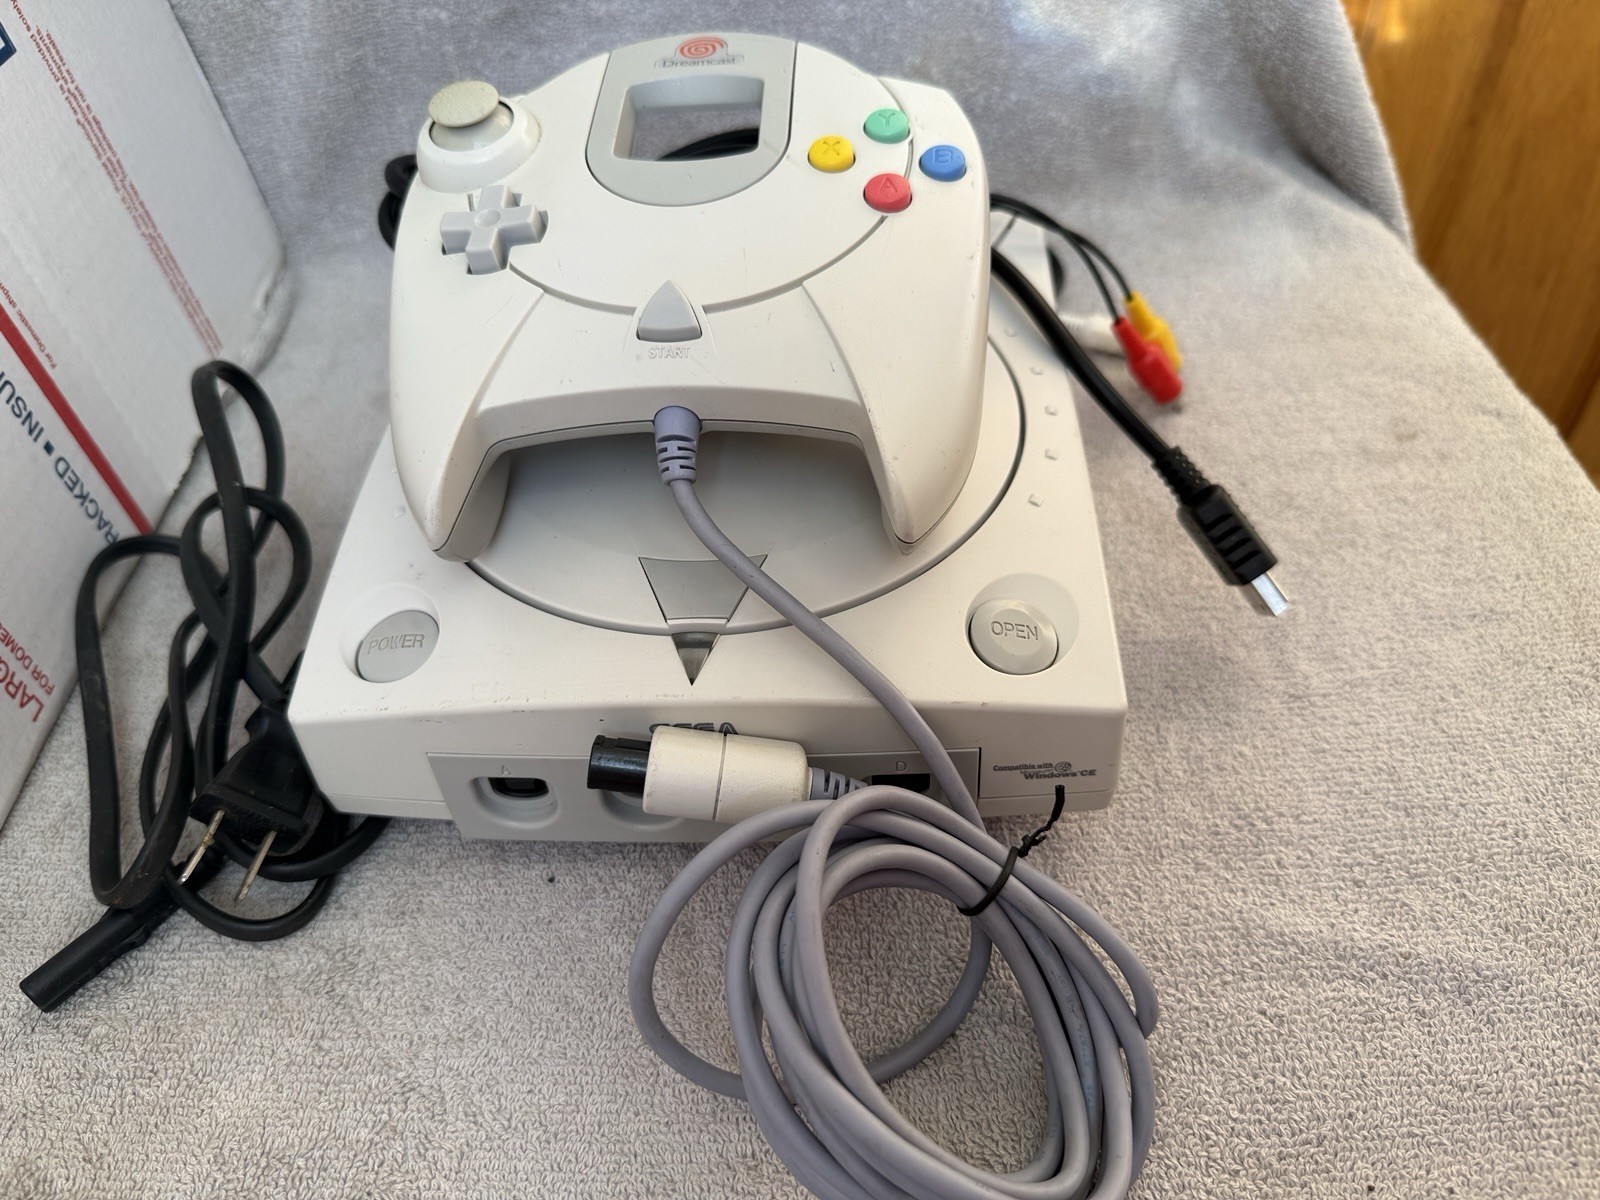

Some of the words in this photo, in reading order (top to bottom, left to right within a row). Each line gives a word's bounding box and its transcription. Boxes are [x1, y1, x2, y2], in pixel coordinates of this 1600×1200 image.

[10, 0, 32, 32] solely
[35, 25, 69, 86] shipments.
[45, 29, 67, 66] resale.
[29, 33, 60, 82] provided
[662, 57, 736, 69] Dreamcast
[64, 68, 76, 83] for
[57, 83, 66, 95] is
[74, 84, 87, 102] not
[64, 96, 78, 115] and
[877, 112, 896, 127] Y
[822, 141, 841, 156] X
[932, 149, 954, 165] B
[878, 177, 898, 194] A
[16, 308, 46, 352] Domestic
[44, 352, 57, 369] For
[648, 346, 691, 359] START
[53, 456, 119, 545] RACKED
[990, 620, 1039, 641] OPEN
[0, 622, 33, 670] DOME
[367, 633, 426, 655] POWER
[31, 664, 56, 696] FOR
[895, 761, 907, 772] D
[993, 763, 1035, 772] Compatible
[1036, 762, 1054, 770] with
[1080, 769, 1097, 777] CE
